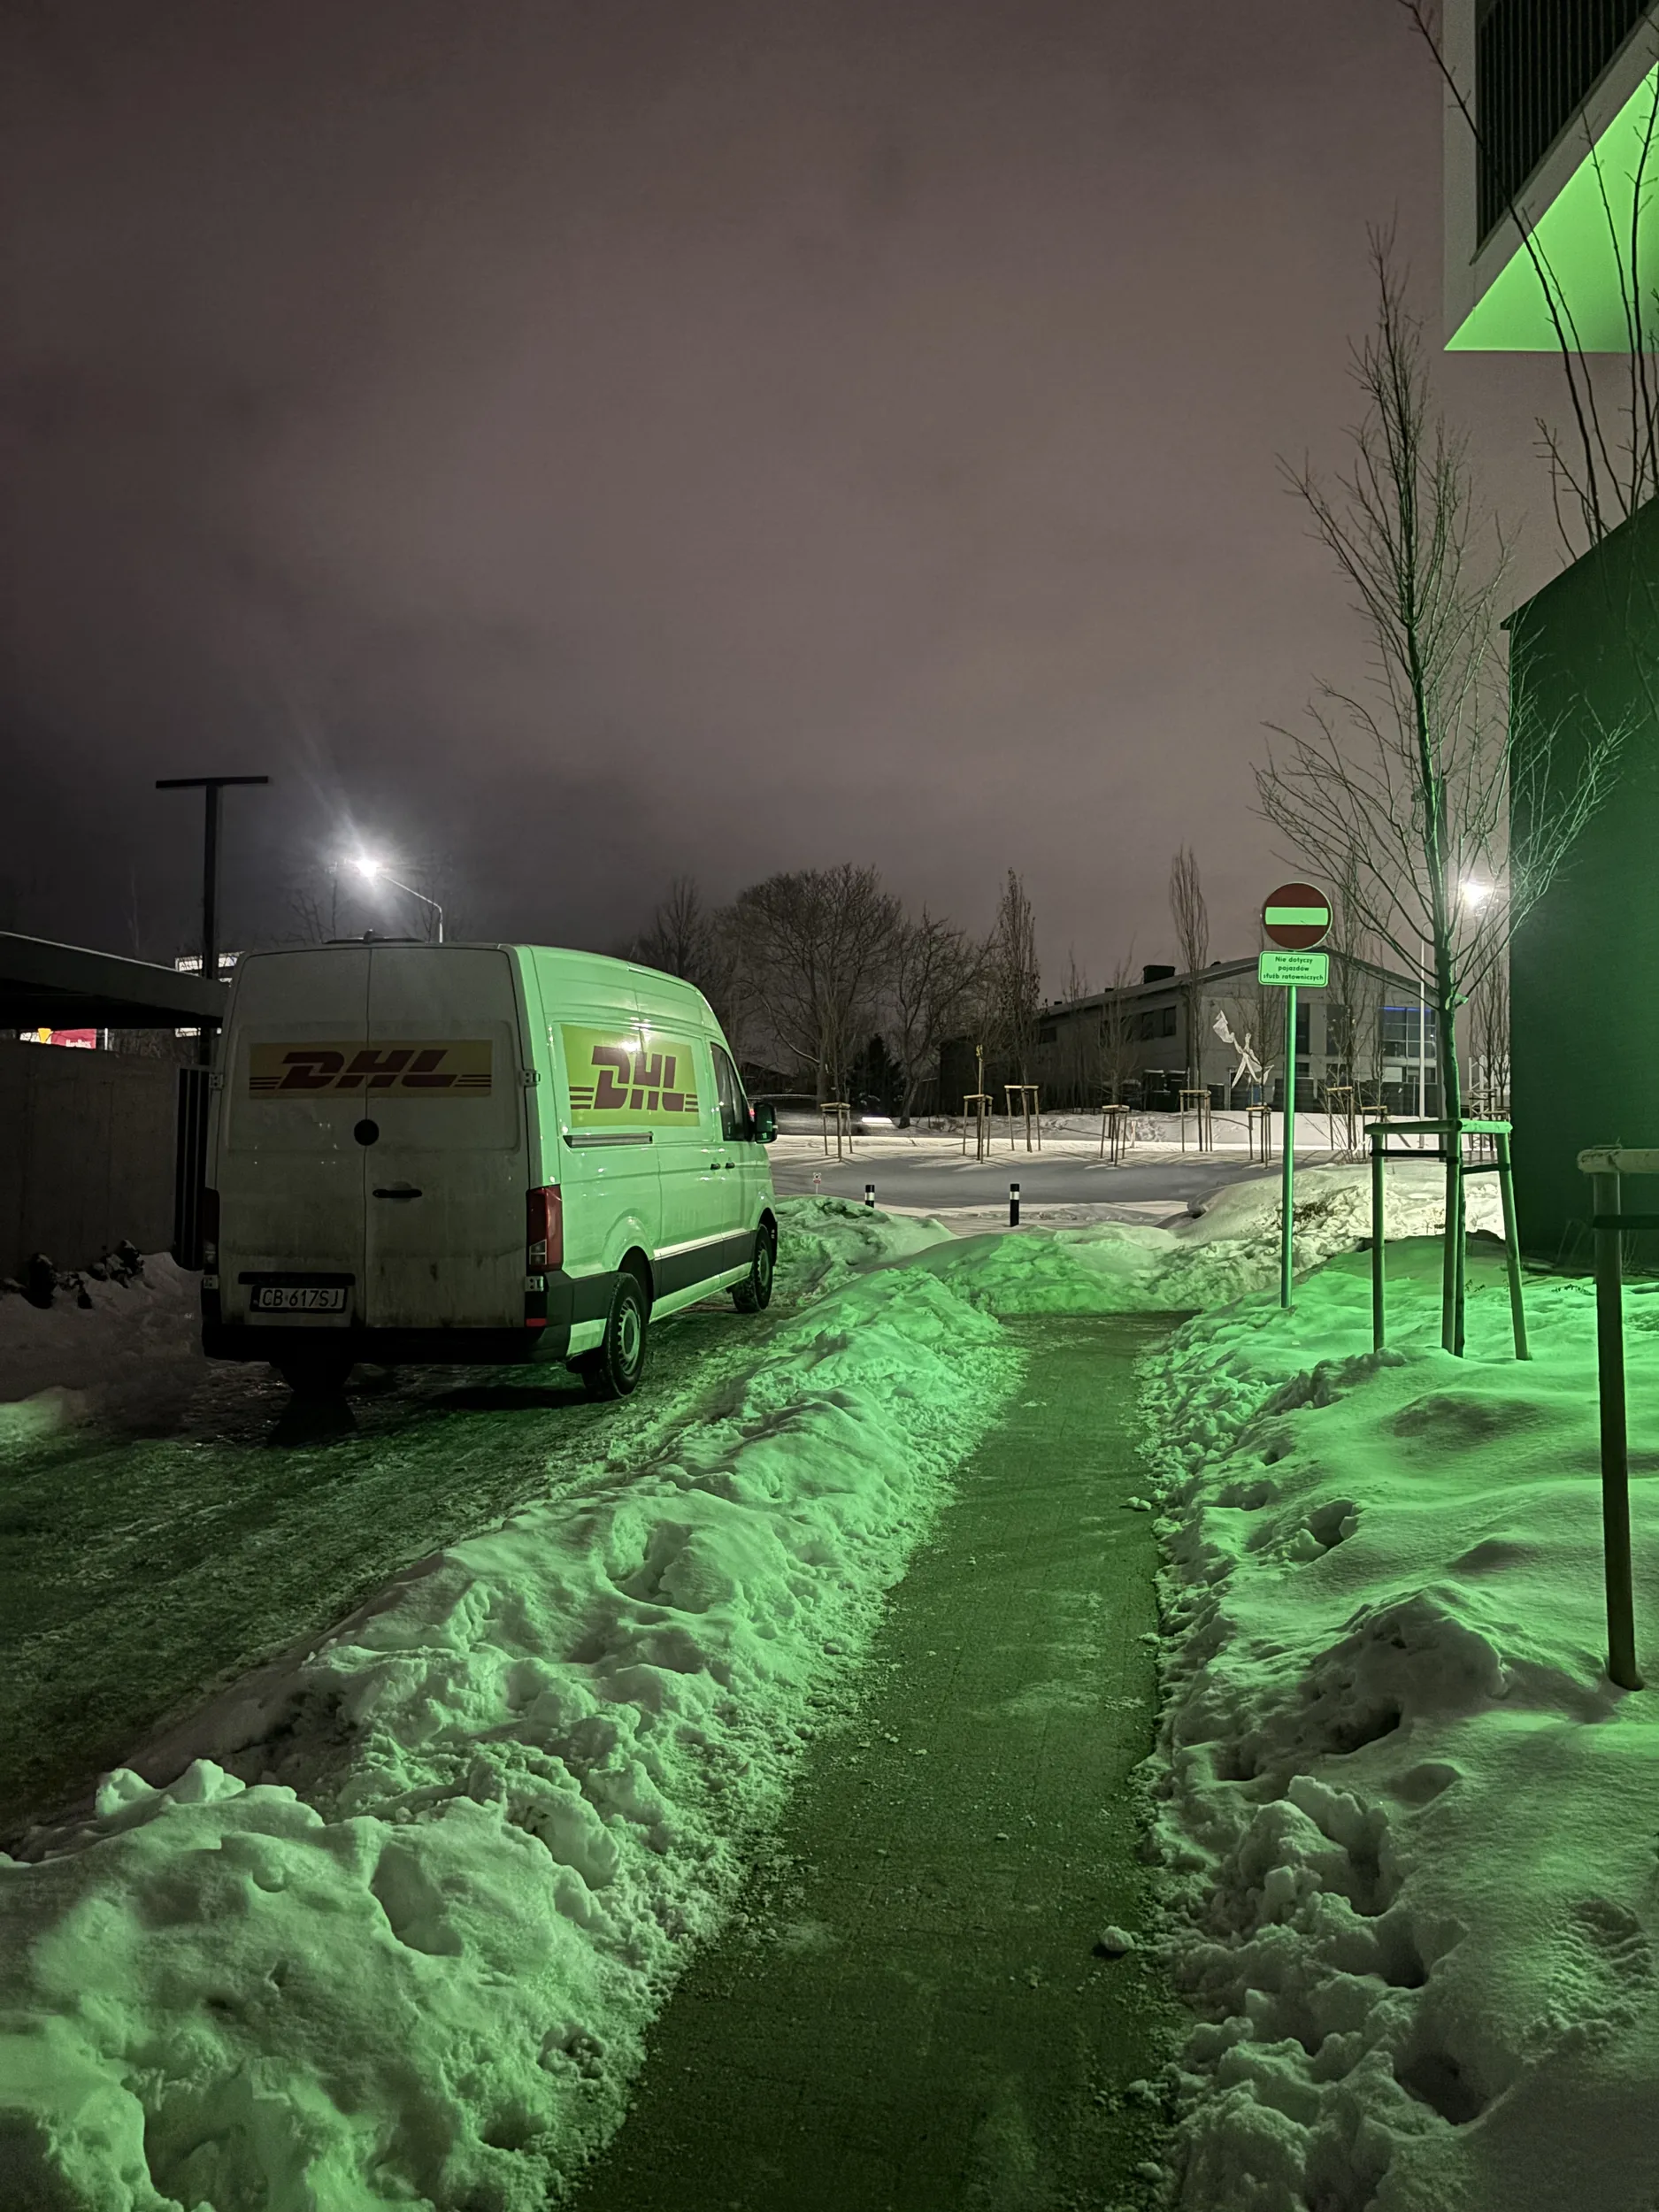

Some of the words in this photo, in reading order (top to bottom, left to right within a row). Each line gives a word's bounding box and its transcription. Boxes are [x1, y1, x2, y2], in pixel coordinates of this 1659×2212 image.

[277, 1049, 457, 1089] DHL
[591, 1045, 685, 1112] DHL
[263, 1289, 283, 1307] CB
[289, 1290, 339, 1307] 617SJ
